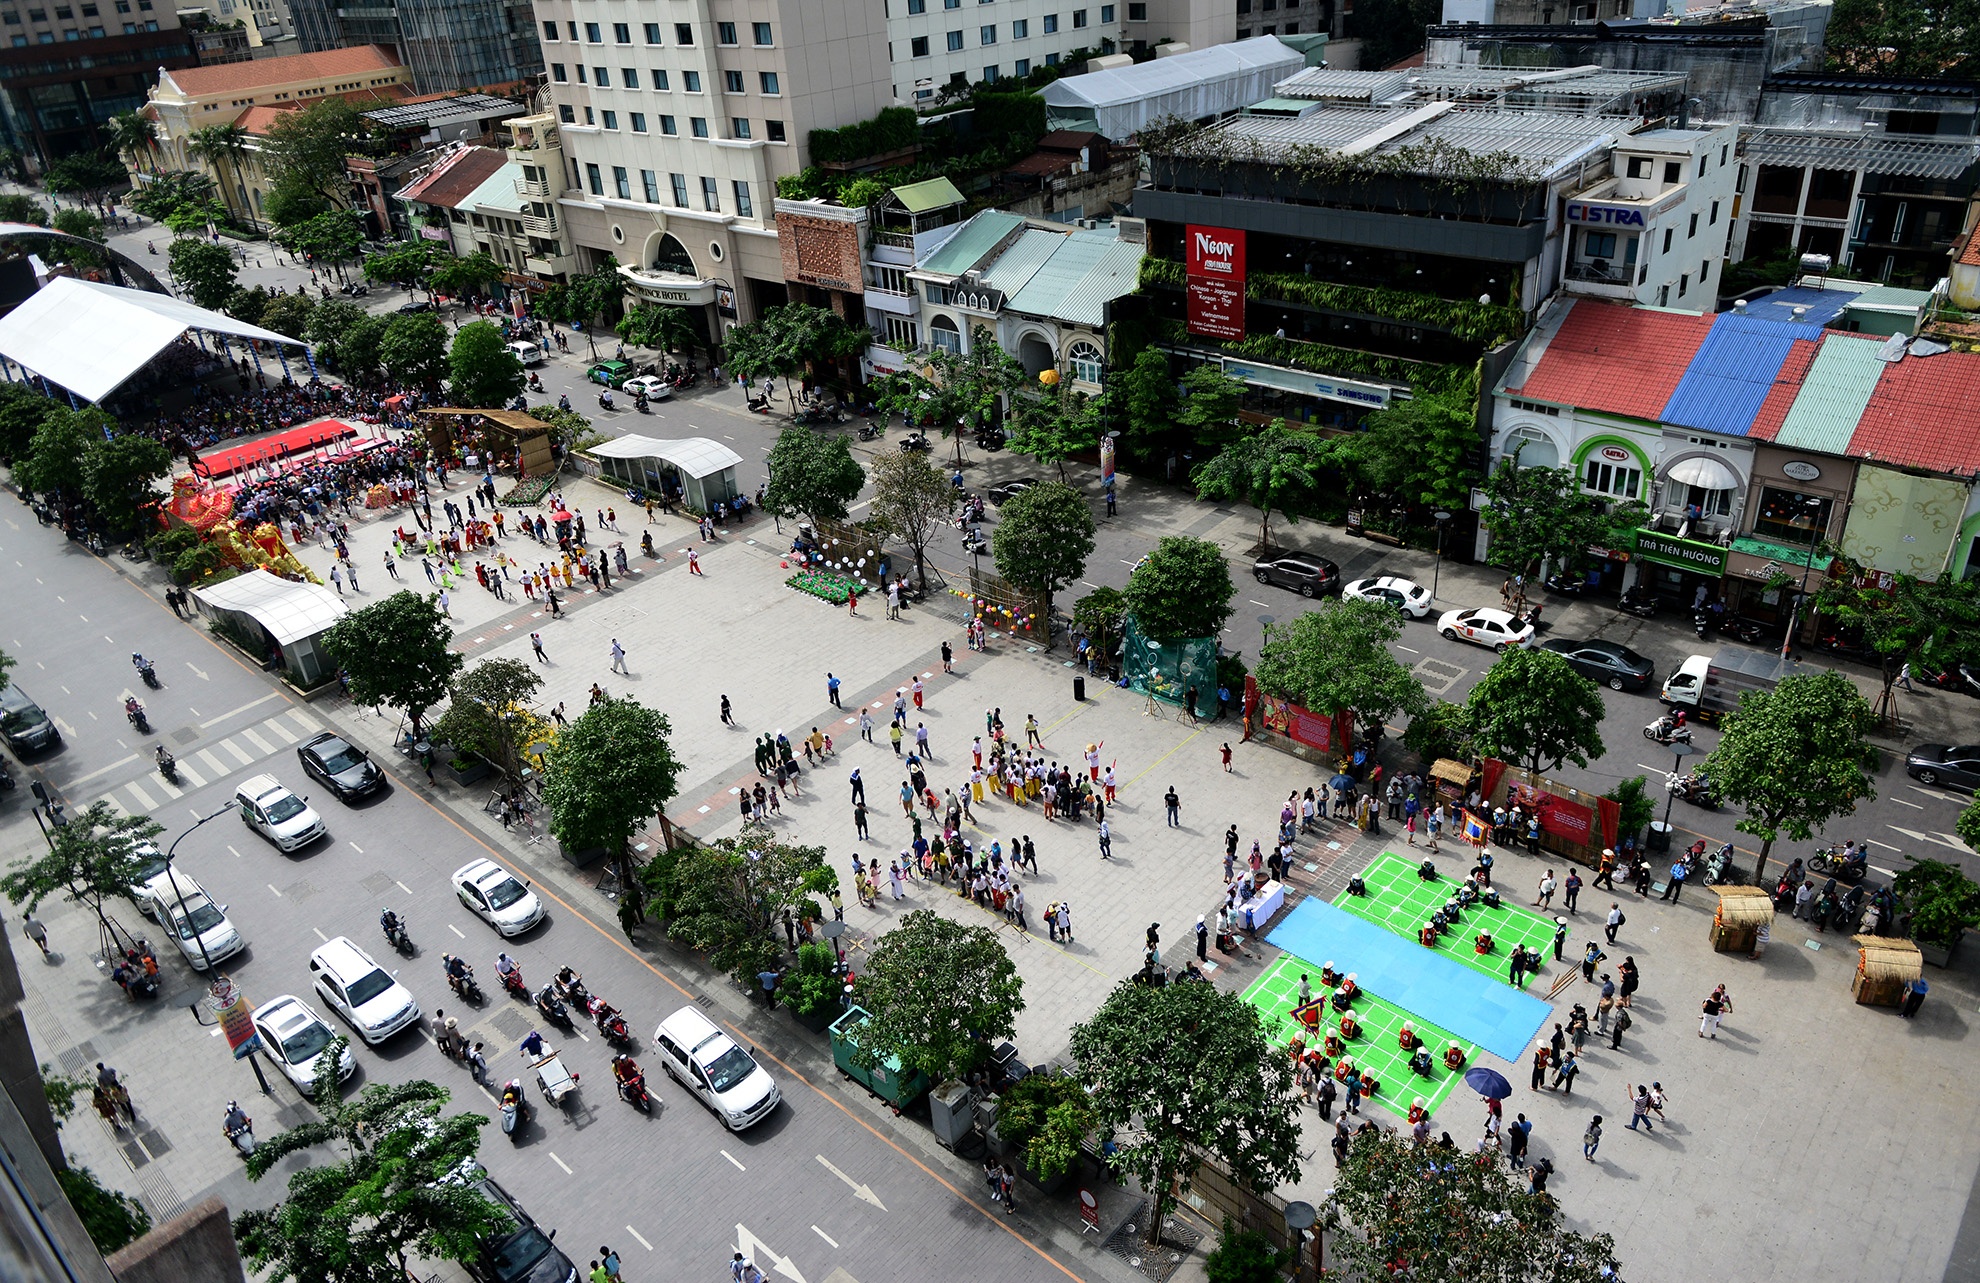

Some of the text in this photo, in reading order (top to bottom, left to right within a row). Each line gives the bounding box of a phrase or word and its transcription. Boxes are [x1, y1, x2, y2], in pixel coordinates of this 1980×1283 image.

[1567, 204, 1644, 226] CISTRA
[661, 291, 690, 301] HOTEL
[1190, 284, 1210, 292] Chinese
[1214, 288, 1238, 296] Japanese
[1201, 311, 1229, 320] Vietnamese
[1337, 387, 1383, 404] SAMSUNG
[1659, 543, 1680, 556] TIÊN
